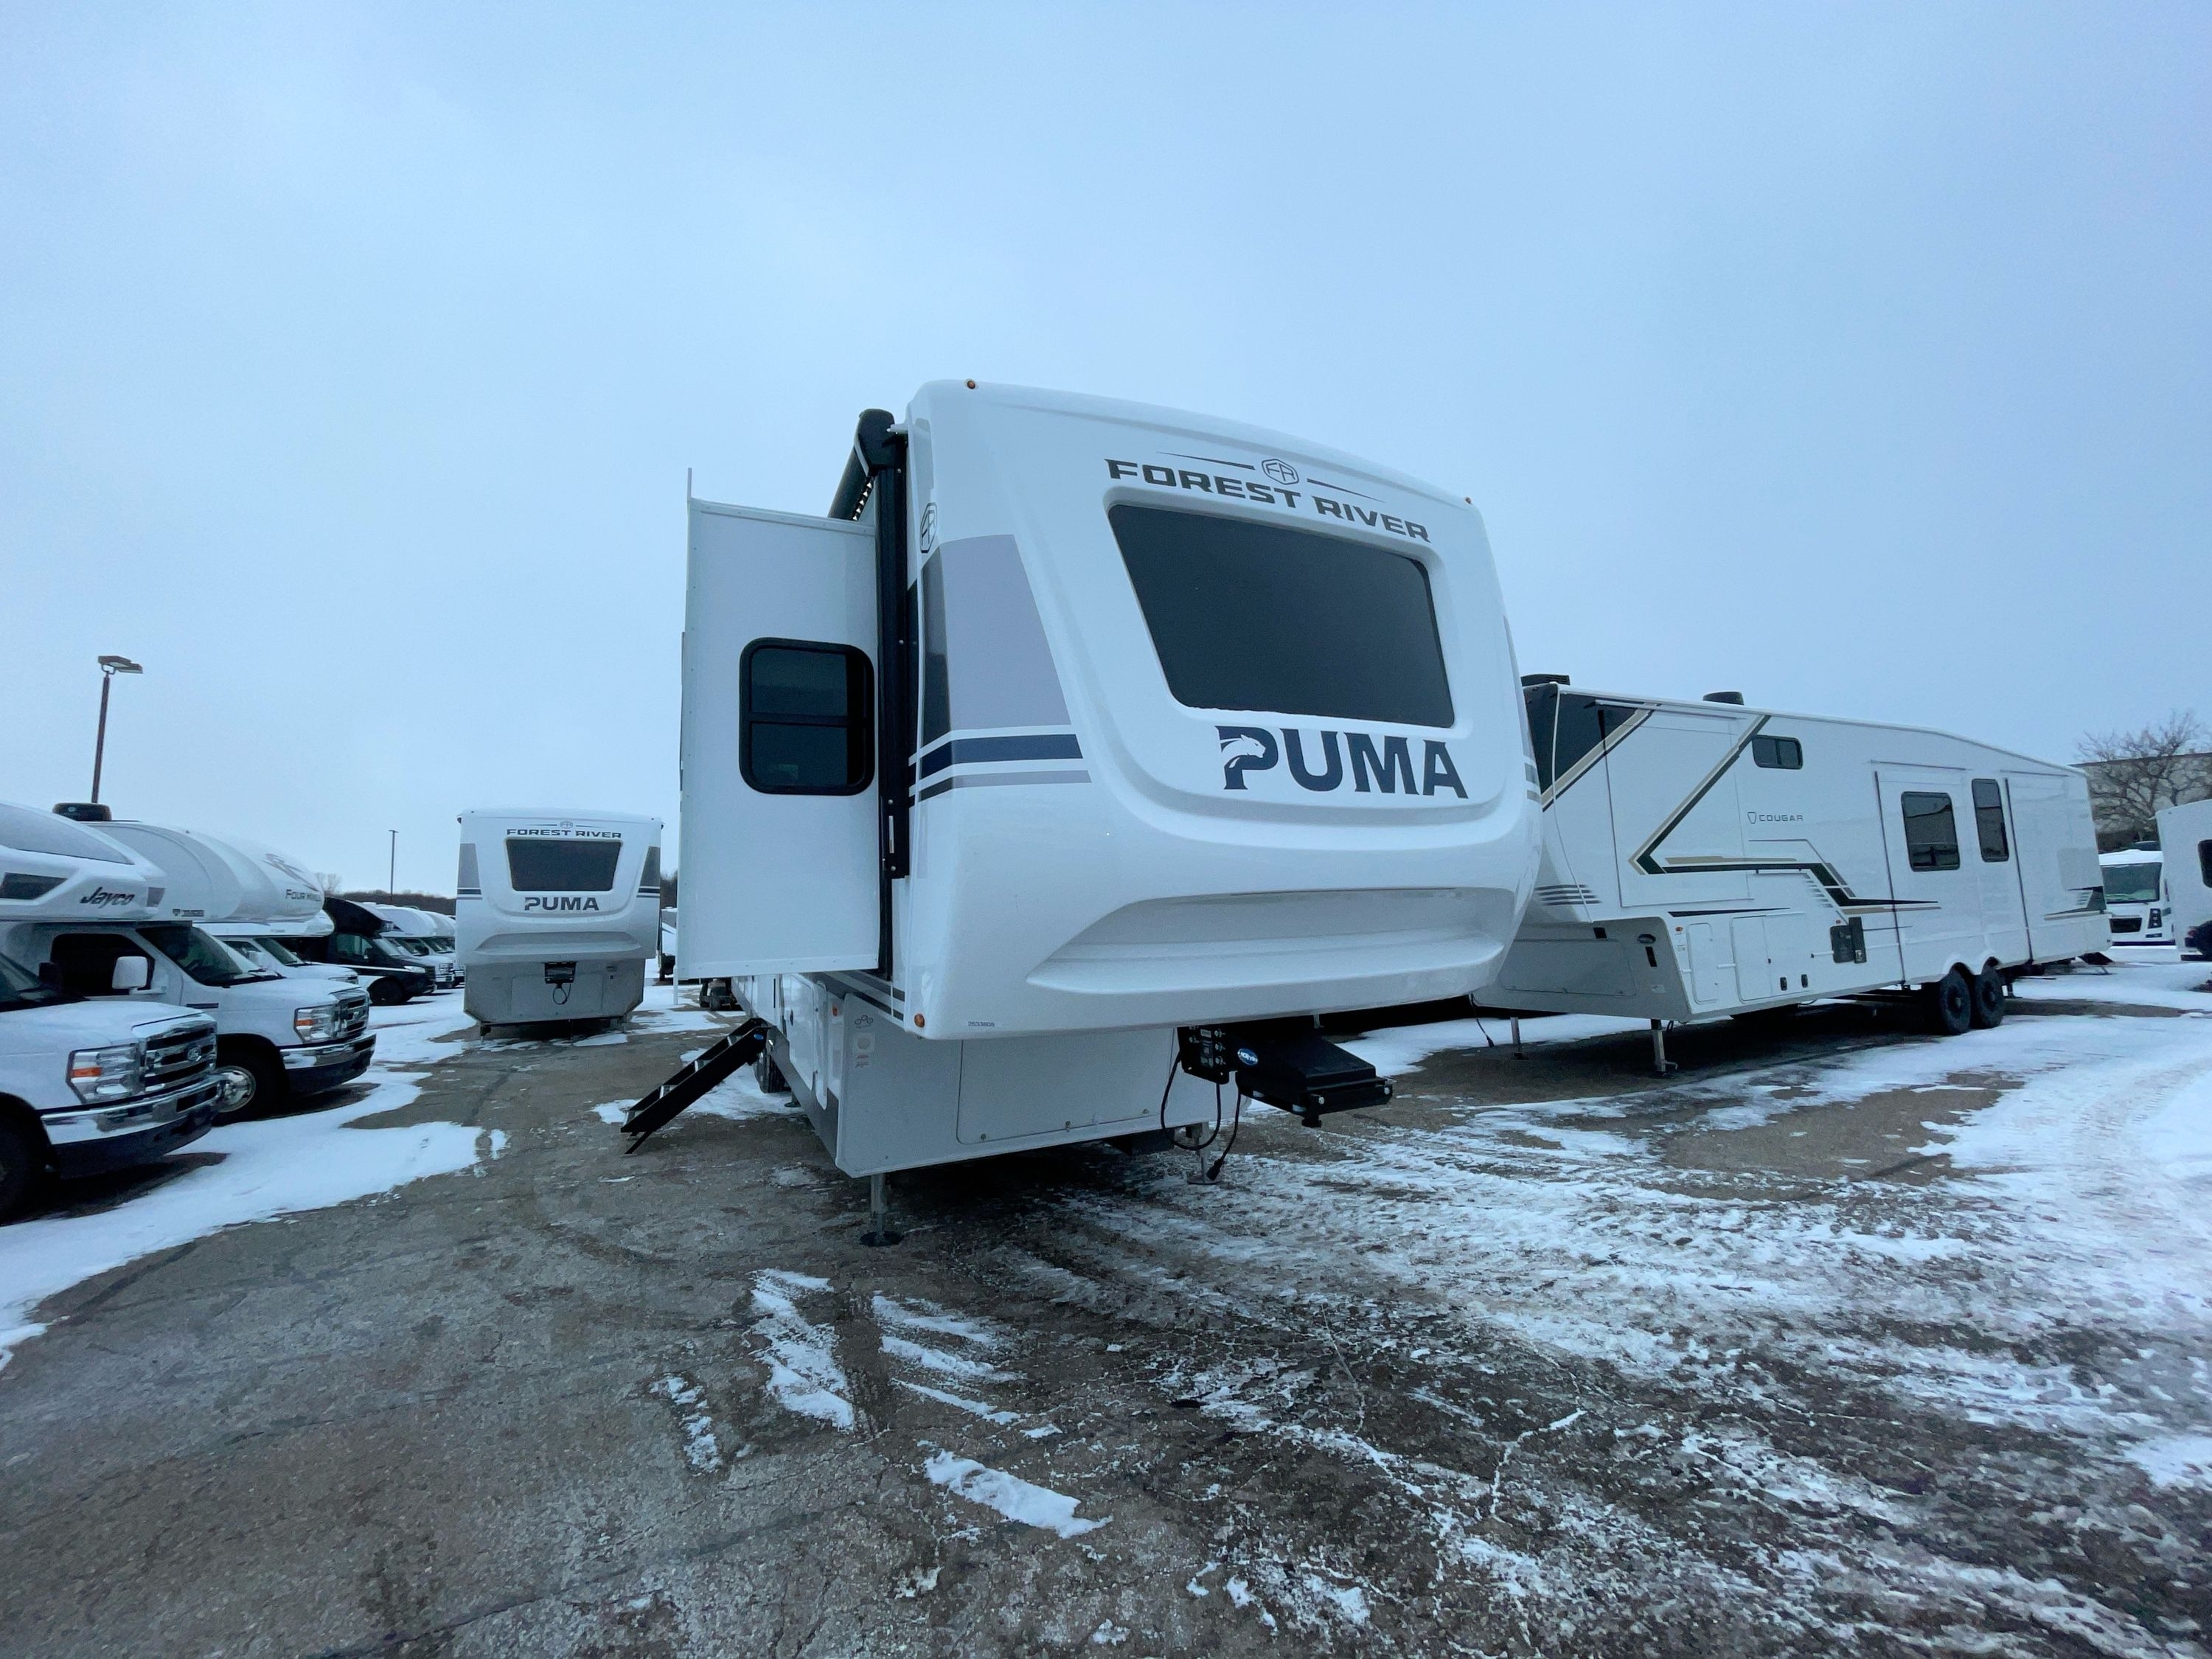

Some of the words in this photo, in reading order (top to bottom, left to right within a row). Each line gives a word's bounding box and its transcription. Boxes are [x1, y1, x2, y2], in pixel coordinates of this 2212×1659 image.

[1265, 462, 1296, 481] FR
[1104, 458, 1301, 509] FOREST
[1310, 495, 1431, 543] RIVER
[1214, 725, 1469, 799] PUMA
[575, 830, 622, 838] RIVER
[80, 886, 136, 909] Jayco
[524, 897, 599, 911] PUMA
